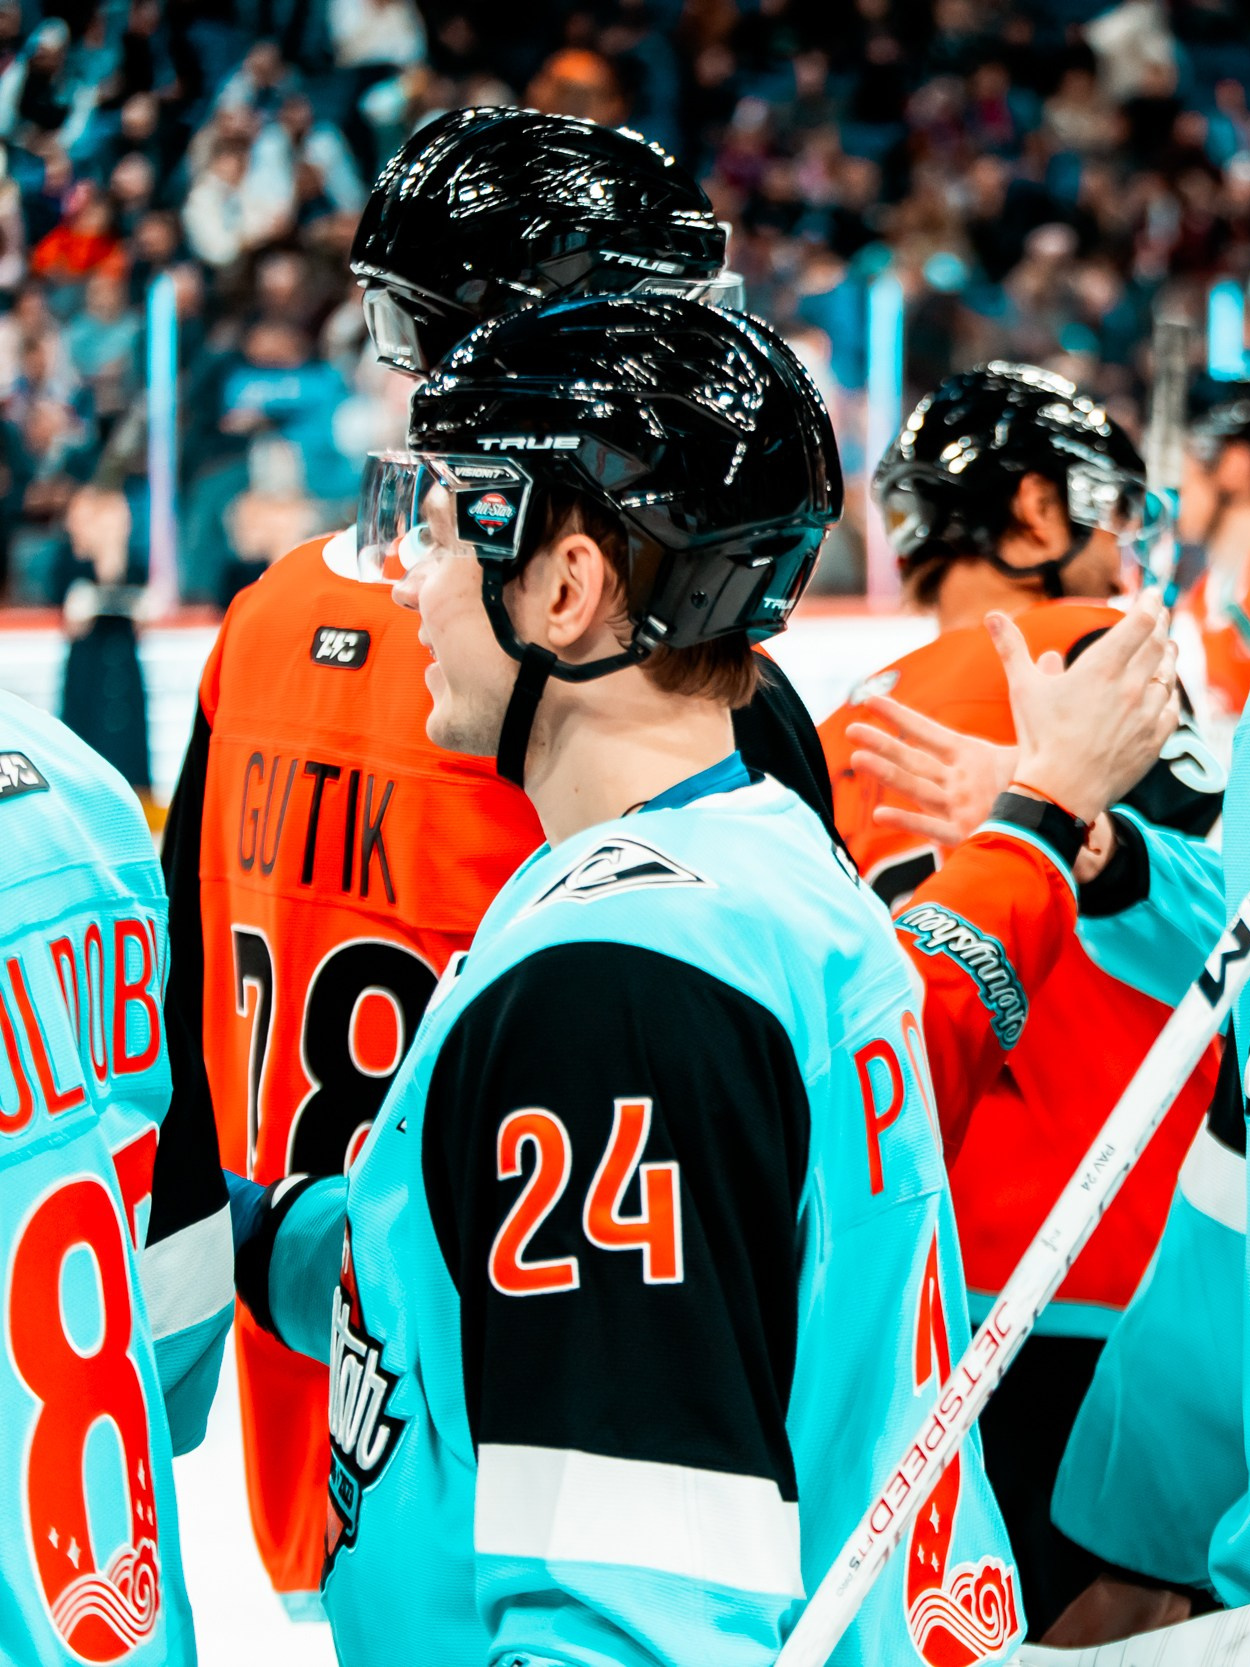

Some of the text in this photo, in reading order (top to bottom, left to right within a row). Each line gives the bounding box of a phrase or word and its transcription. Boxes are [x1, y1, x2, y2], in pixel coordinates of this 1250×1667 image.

[599, 250, 679, 274] TRUE
[477, 436, 581, 451] TRUE
[239, 751, 397, 904] GUTIK
[231, 923, 443, 1186] 78
[487, 1097, 685, 1298] 24
[869, 1301, 1012, 1534] JETSPEED
